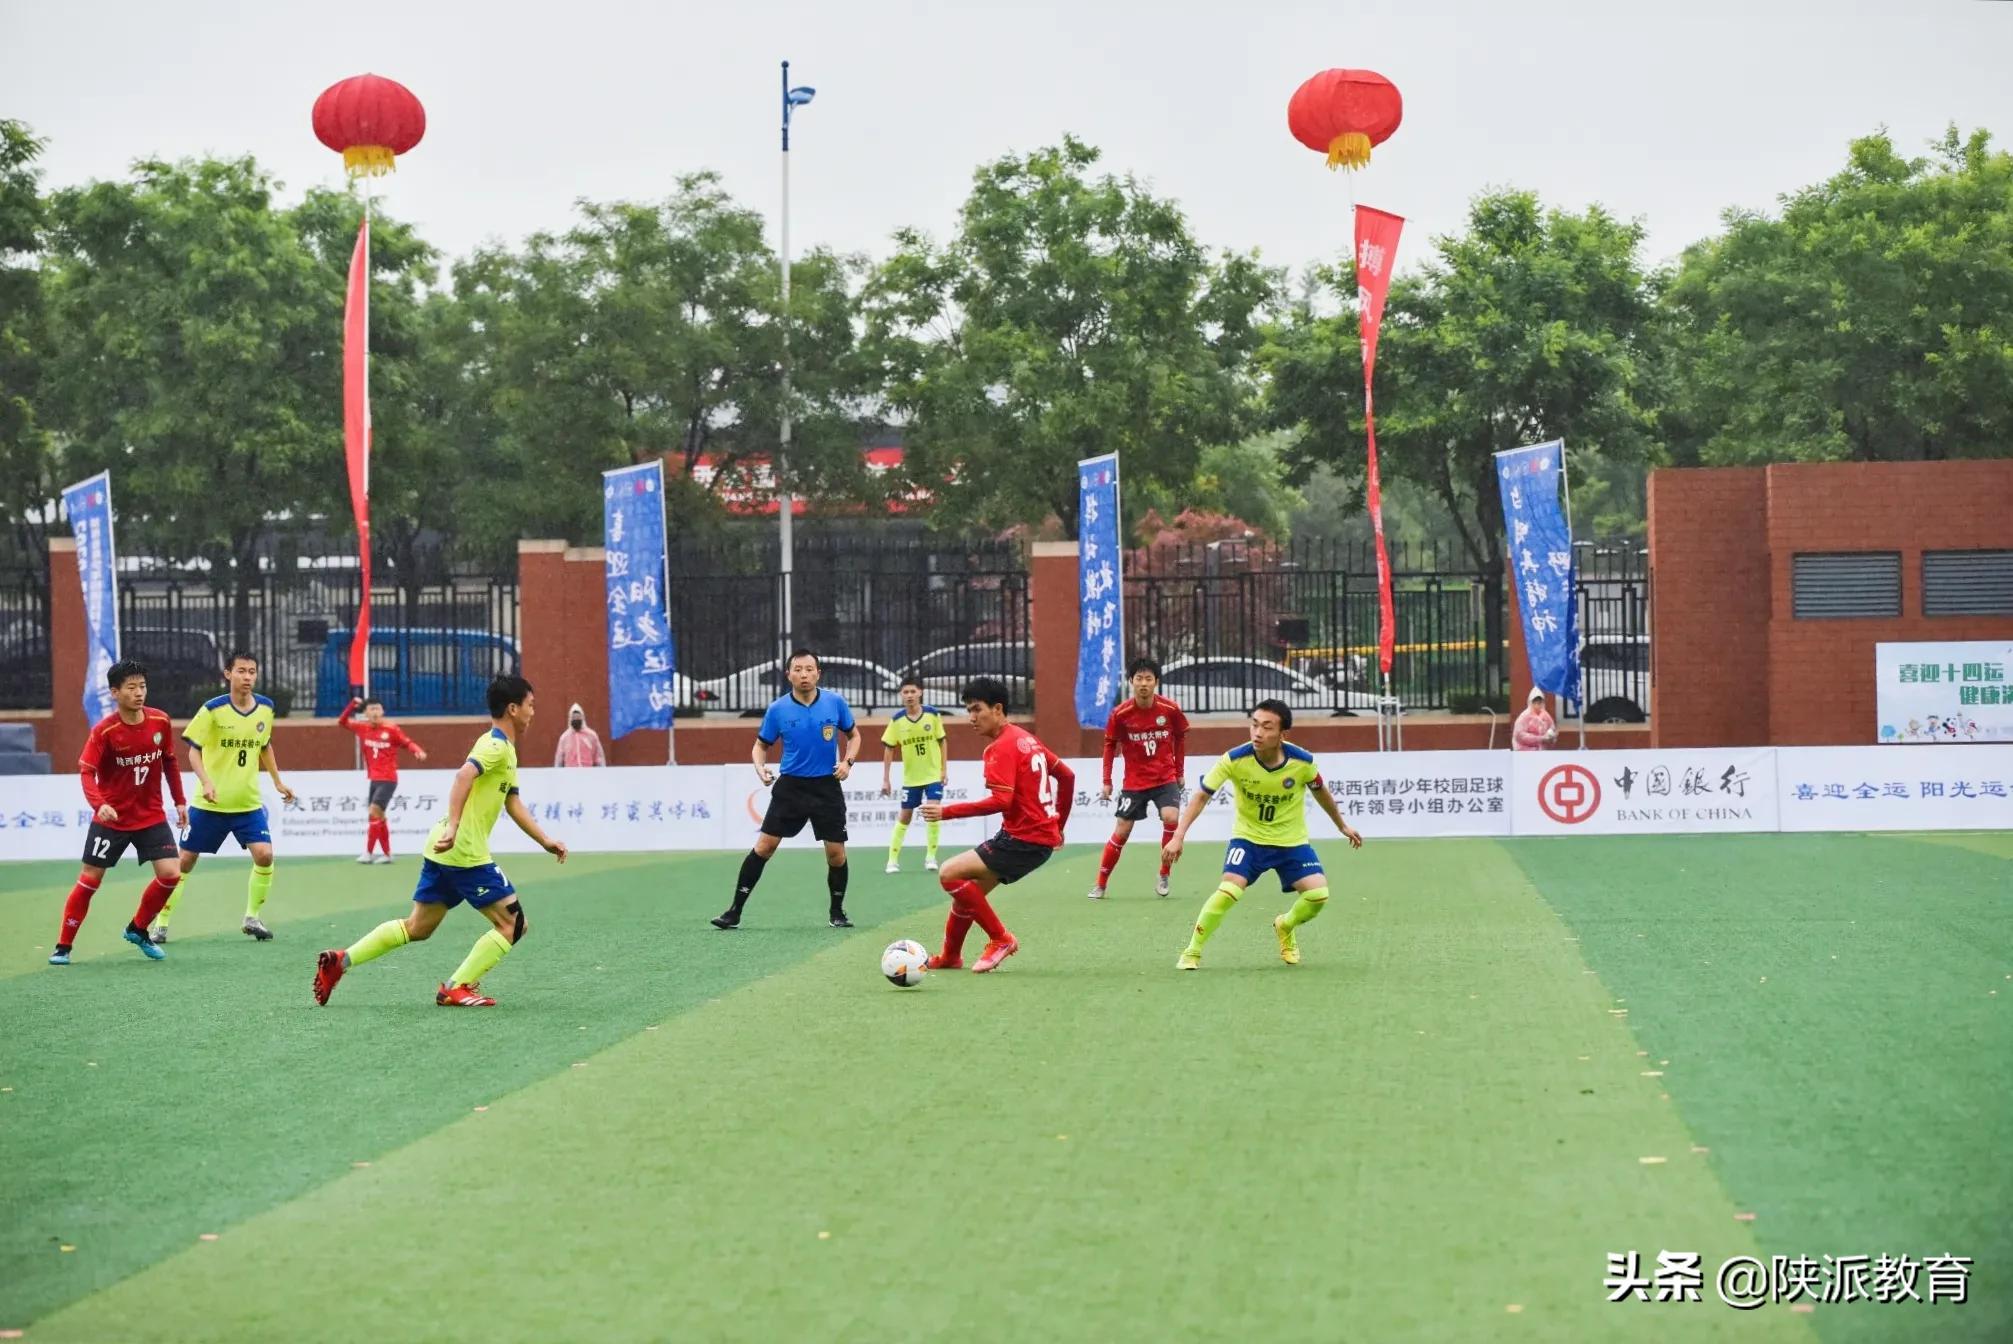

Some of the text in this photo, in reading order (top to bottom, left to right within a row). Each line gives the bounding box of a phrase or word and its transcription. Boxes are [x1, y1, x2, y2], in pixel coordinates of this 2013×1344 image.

[1898, 662, 2004, 682] 喜迎十四运
[914, 743, 926, 756] 15
[1143, 740, 1157, 756] 19
[237, 750, 247, 767] 8
[133, 766, 150, 786] 17
[1328, 777, 1504, 796] 陕西省青少年校园足球
[1791, 780, 2013, 800] 喜迎全运 阳光运
[282, 794, 438, 812] 陕西省育厅
[1258, 803, 1276, 822] 10
[1617, 807, 1753, 822] BANK OF CHINA
[92, 836, 111, 859] 12
[1226, 847, 1246, 866] 10
